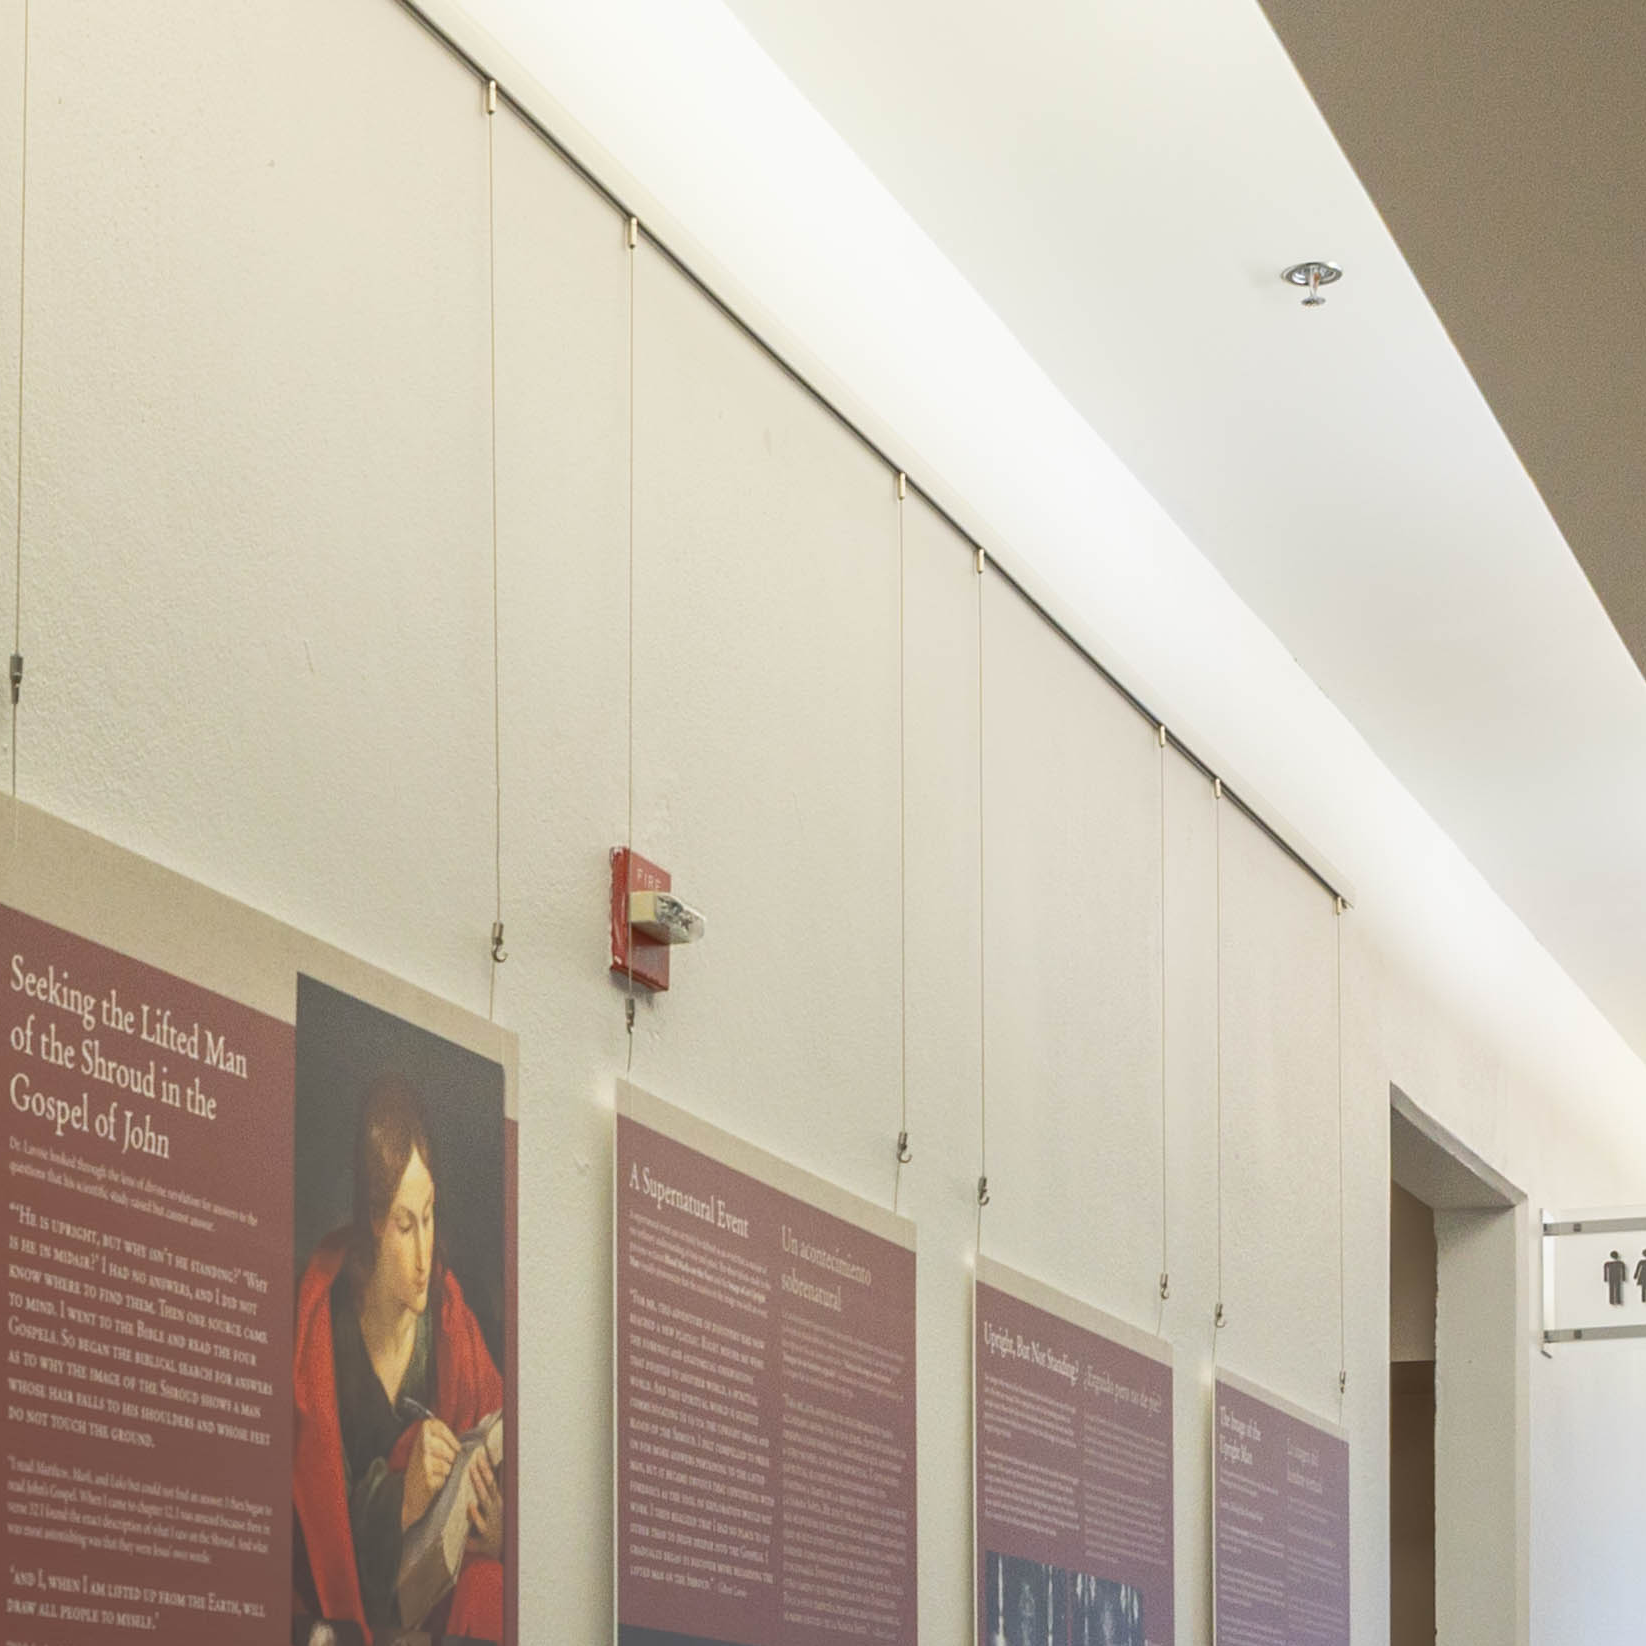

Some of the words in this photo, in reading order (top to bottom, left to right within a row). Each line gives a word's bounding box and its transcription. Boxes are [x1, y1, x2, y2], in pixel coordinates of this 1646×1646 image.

[636, 868, 662, 889] FIRE
[9, 953, 96, 1032] Seeking
[101, 988, 135, 1035] the
[139, 1002, 200, 1061] Lifted
[203, 1029, 248, 1079] Man
[9, 1012, 35, 1056] of
[39, 1021, 75, 1070] the
[80, 1037, 156, 1099] Shroud
[160, 1065, 181, 1108] in
[185, 1076, 217, 1121] the
[8, 1071, 89, 1137] Gospel
[93, 1100, 118, 1142] of
[121, 1108, 169, 1159] John
[628, 1161, 640, 1191] A
[641, 1165, 715, 1224] Supernatural
[716, 1198, 749, 1239] Event
